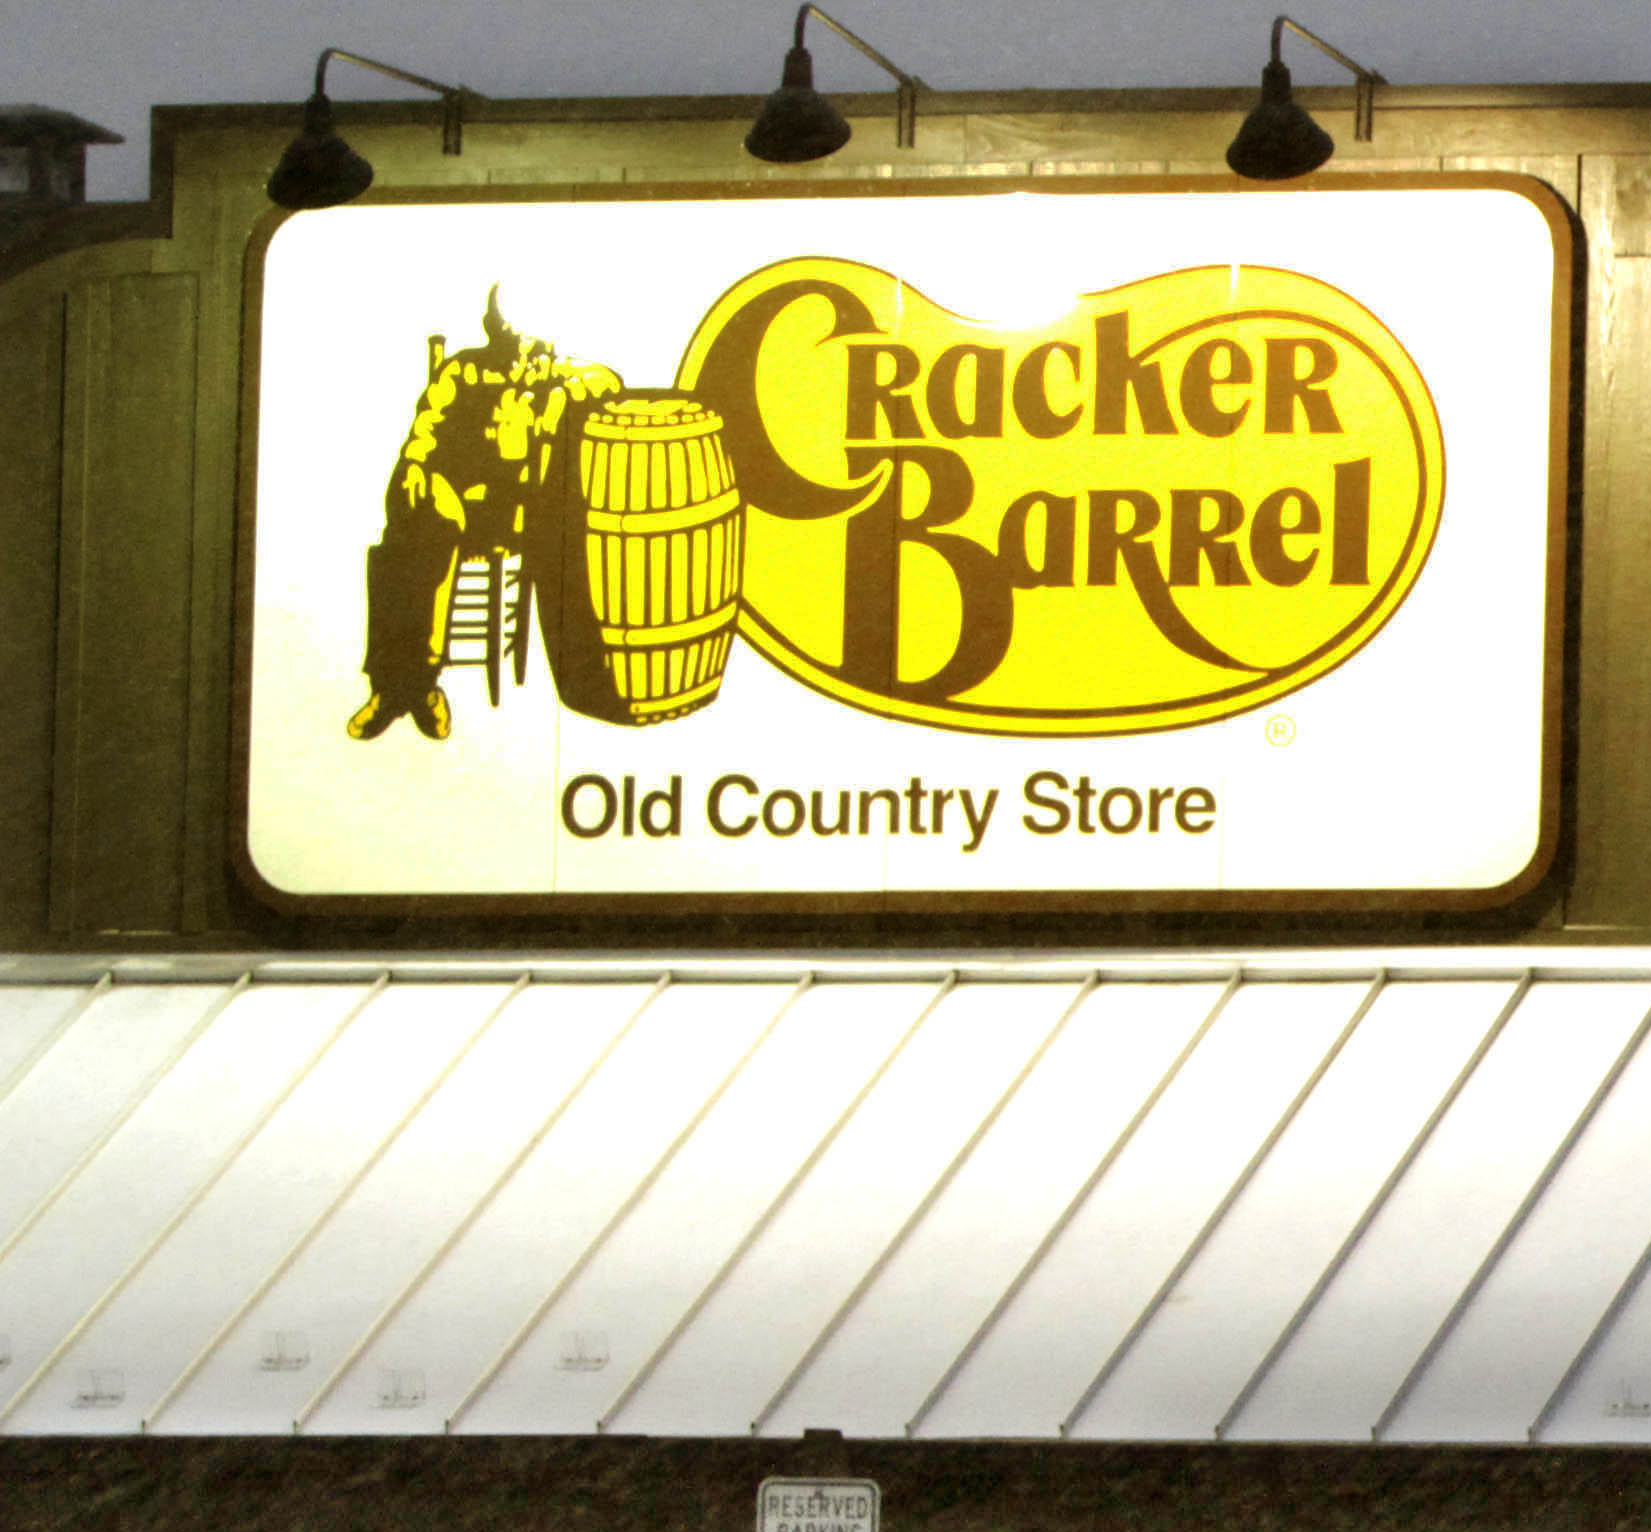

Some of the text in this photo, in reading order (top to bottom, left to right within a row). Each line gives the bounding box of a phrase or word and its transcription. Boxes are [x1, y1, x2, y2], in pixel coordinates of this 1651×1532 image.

[697, 279, 1344, 520] Cracker
[843, 445, 1372, 701] Barrel
[561, 769, 1217, 853] Old Country Store
[768, 1495, 868, 1519] RESERVED
